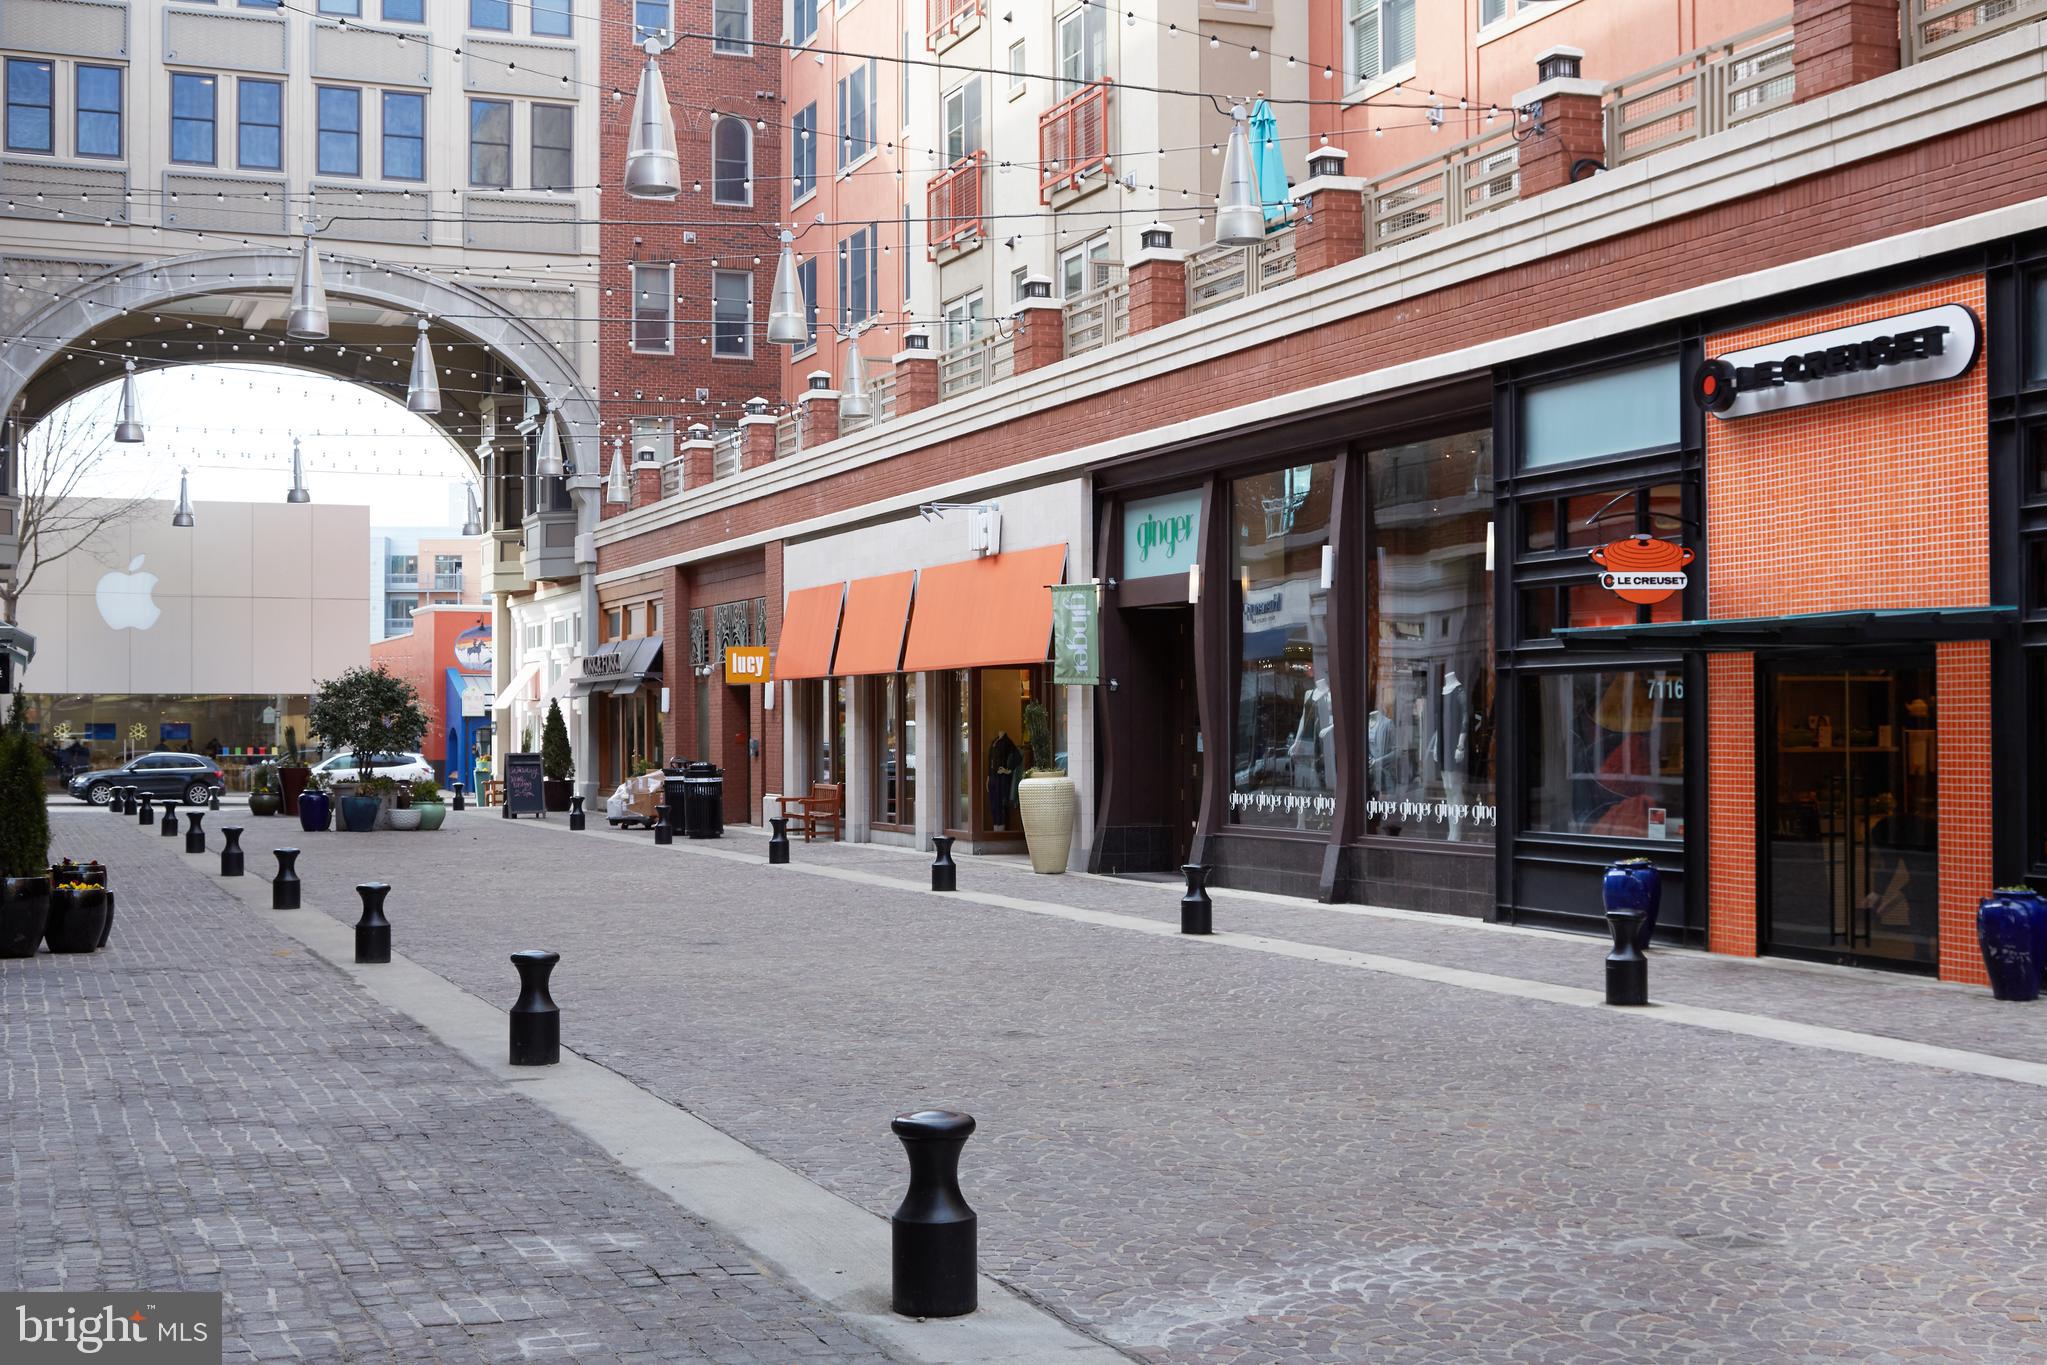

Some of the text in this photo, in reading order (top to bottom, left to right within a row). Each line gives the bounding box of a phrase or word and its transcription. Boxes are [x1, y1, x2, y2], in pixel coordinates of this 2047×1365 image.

[1736, 325, 1950, 392] LE CREUSET
[1137, 514, 1193, 562] ginger
[1617, 576, 1686, 585] LE CREUSET
[1063, 592, 1090, 674] ginger
[732, 652, 764, 677] lucy
[1647, 679, 1684, 699] 7116
[1229, 790, 1253, 811] ginger
[1256, 790, 1282, 812] ginger
[1284, 792, 1312, 814] ginger
[1366, 797, 1397, 820] ginger
[1400, 799, 1431, 822] ginger
[1435, 800, 1469, 824] ginger
